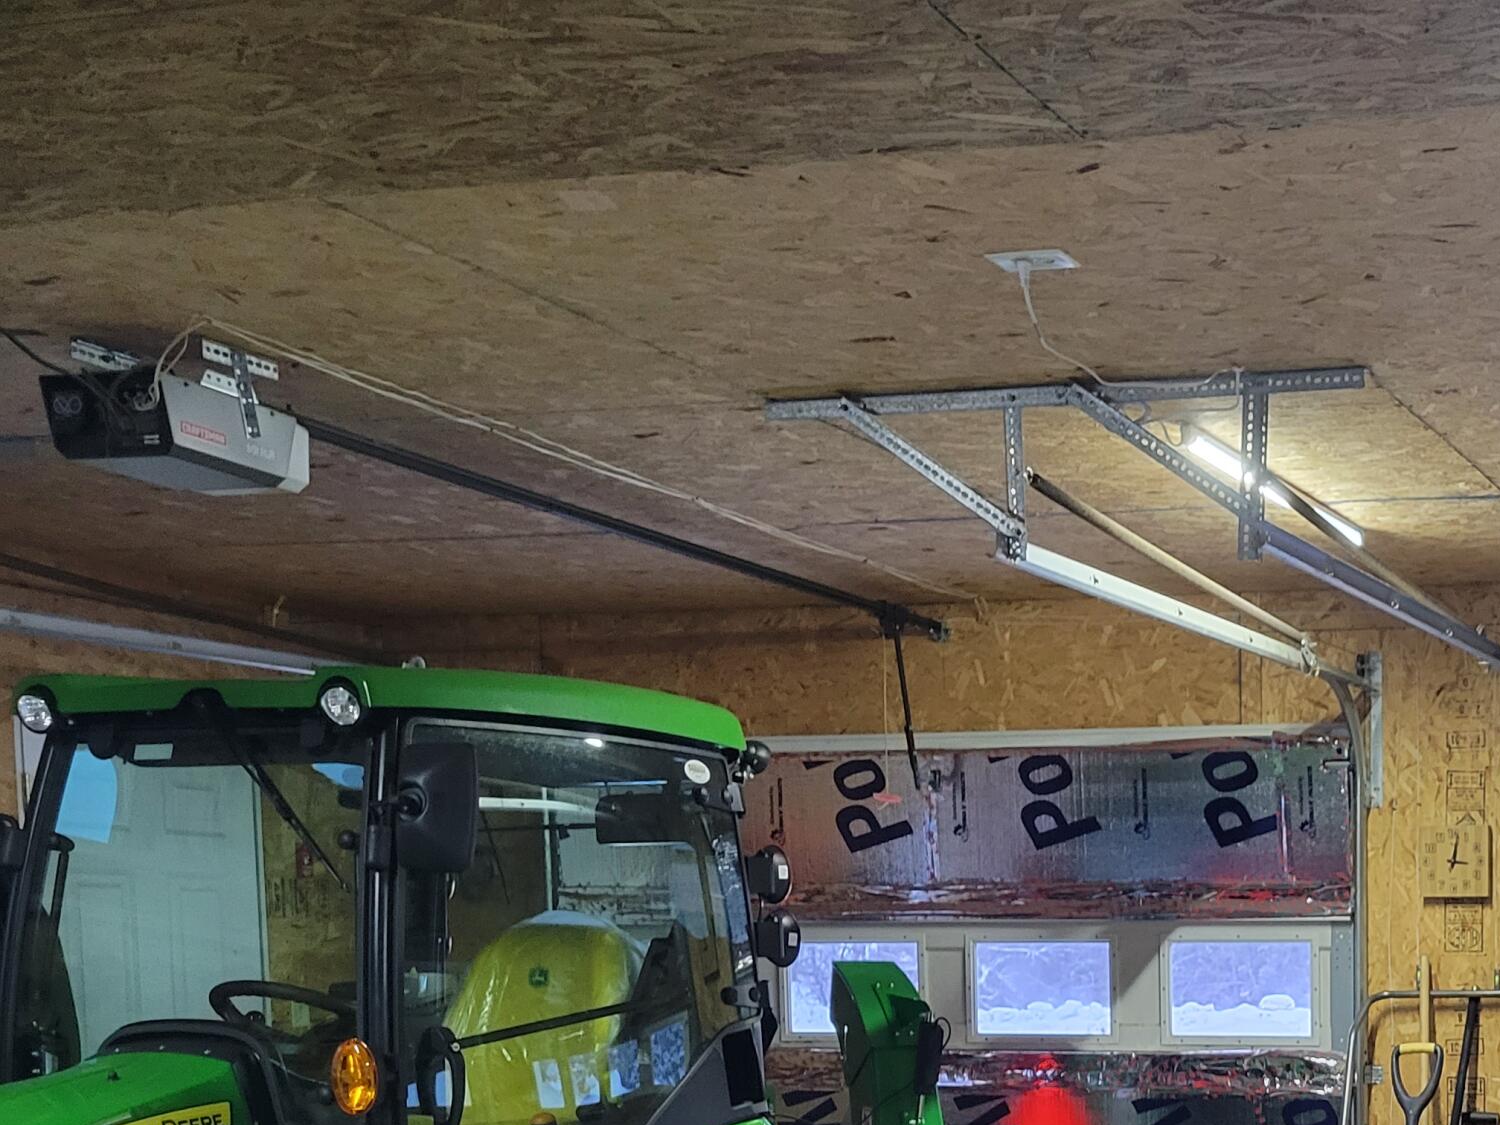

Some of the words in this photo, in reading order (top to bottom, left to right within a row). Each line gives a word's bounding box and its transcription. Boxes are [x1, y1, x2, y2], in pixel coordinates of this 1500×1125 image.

[803, 758, 913, 852] Po
[988, 754, 1102, 850] Po
[1172, 751, 1277, 848] Po
